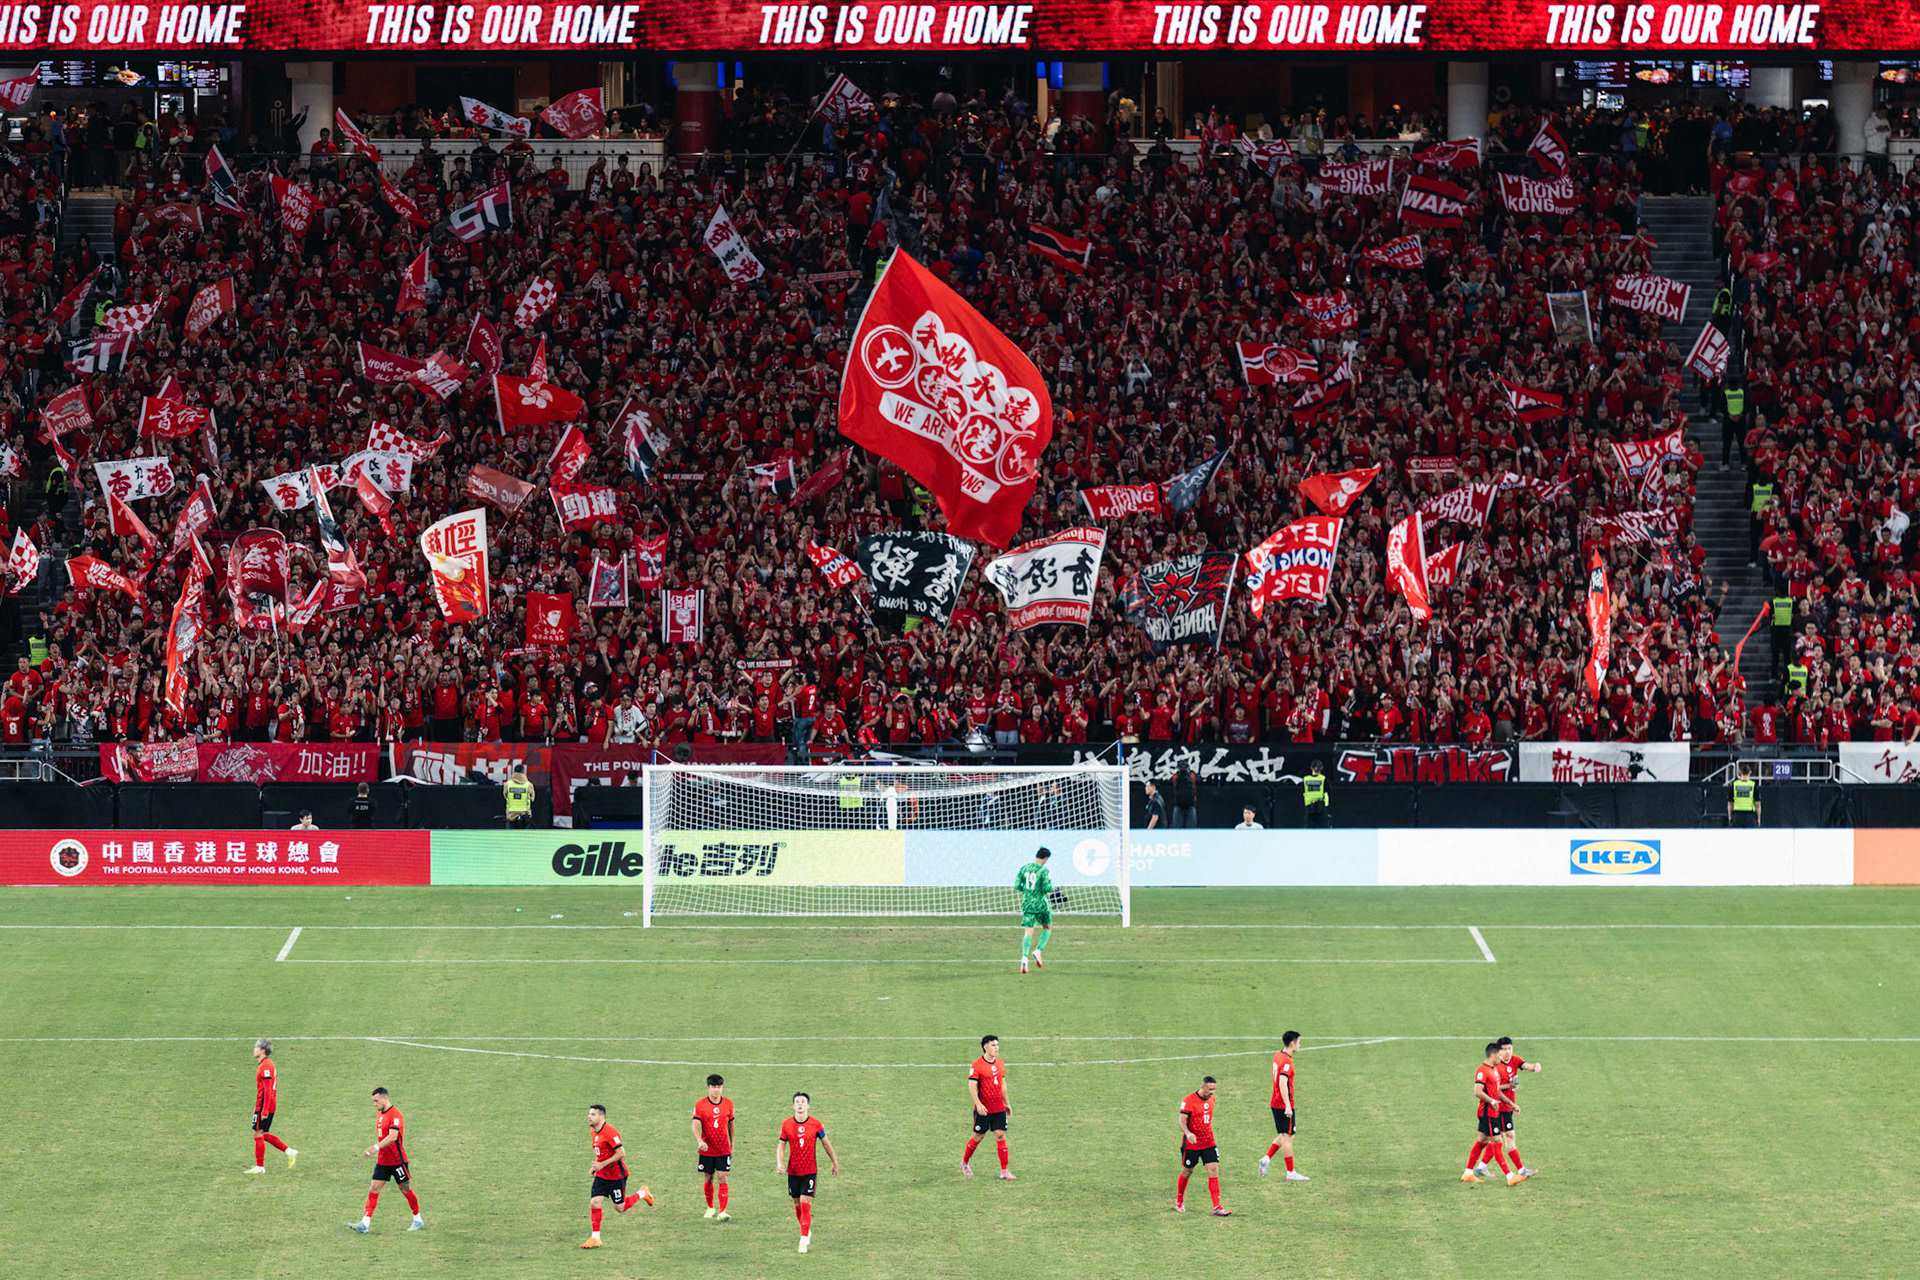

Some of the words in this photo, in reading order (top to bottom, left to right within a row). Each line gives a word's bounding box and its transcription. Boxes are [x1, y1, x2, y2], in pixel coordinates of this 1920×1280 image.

[47, 5, 81, 43] IS
[87, 5, 148, 43] OUR
[156, 5, 245, 43] HOME
[367, 5, 435, 43] THIS
[440, 5, 474, 43] IS
[481, 5, 542, 43] OUR
[550, 5, 640, 43] HOME
[760, 5, 828, 43] THIS
[833, 5, 867, 43] IS
[874, 5, 935, 43] OUR
[943, 5, 1033, 43] HOME
[1153, 5, 1221, 43] THIS
[1226, 5, 1260, 43] IS
[1267, 5, 1328, 43] OUR
[1336, 5, 1426, 43] HOME
[1547, 5, 1615, 43] THIS
[1620, 5, 1654, 43] IS
[1661, 5, 1722, 43] OUR
[1730, 5, 1820, 43] HOME
[1521, 181, 1574, 199] HONG
[1508, 195, 1555, 213] KONG
[894, 400, 915, 425] WE
[919, 414, 946, 439] ARE
[1109, 489, 1155, 505] HONG
[1099, 502, 1138, 518] KONG
[89, 562, 111, 578] WE
[107, 574, 126, 588] ARE
[747, 660, 756, 668] WE
[756, 659, 766, 667] ARE
[766, 659, 778, 667] HONG
[779, 658, 793, 667] KONG
[9, 722, 17, 736] 8
[298, 750, 366, 778] 加油!!
[584, 762, 610, 772] THE
[613, 761, 641, 771] POW
[1775, 765, 1790, 775] 219
[103, 841, 339, 863] 中國香港足球總會
[1117, 843, 1192, 858] HARGE
[1579, 851, 1652, 864] IKEA
[551, 842, 698, 877] Gillete
[103, 866, 120, 874] THE
[123, 866, 168, 874] FOOTBALL
[171, 866, 230, 874] ASSOCIATION
[232, 866, 246, 874] OF
[248, 866, 275, 874] HONG
[278, 866, 307, 875] KONG,
[310, 866, 339, 874] CHINA
[1024, 871, 1037, 890] 19
[712, 1118, 720, 1129] 6
[1202, 1113, 1211, 1125] 12
[798, 1137, 806, 1148] 9
[394, 1165, 407, 1178] 11
[807, 1178, 815, 1190] 9
[612, 1187, 624, 1200] 13
